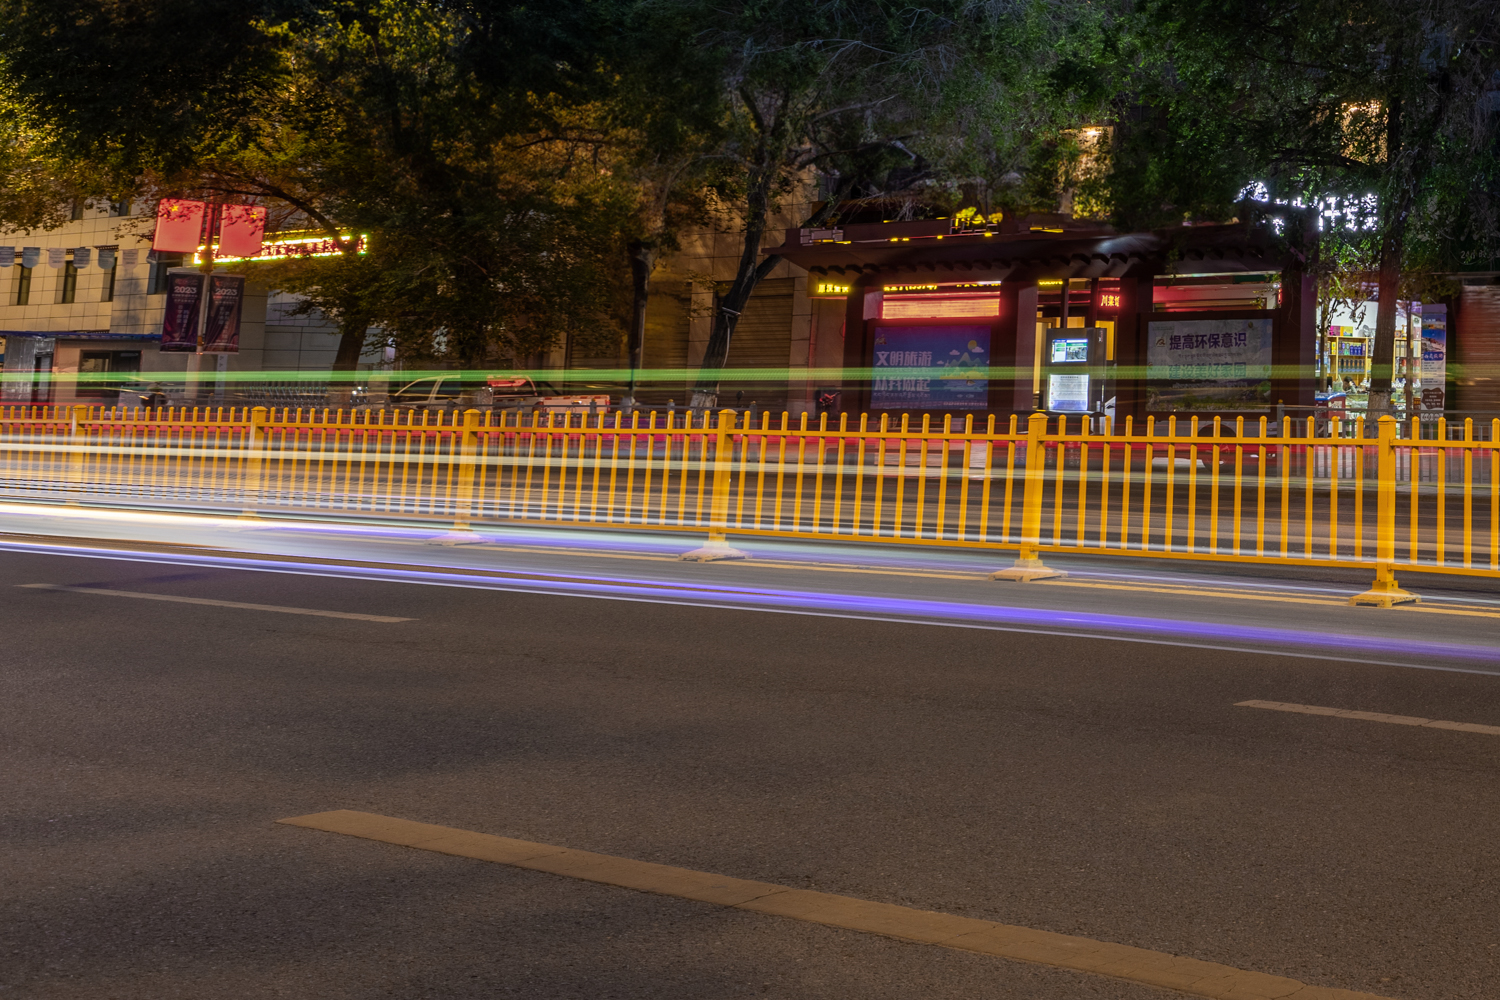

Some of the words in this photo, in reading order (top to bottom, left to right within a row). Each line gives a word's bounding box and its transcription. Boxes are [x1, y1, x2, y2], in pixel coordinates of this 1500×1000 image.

[173, 286, 198, 294] 2023
[214, 288, 238, 296] 2023
[1168, 332, 1247, 351] 提高环保意识
[875, 350, 933, 367] 文明旅游
[1167, 361, 1247, 379] 建设美好家园
